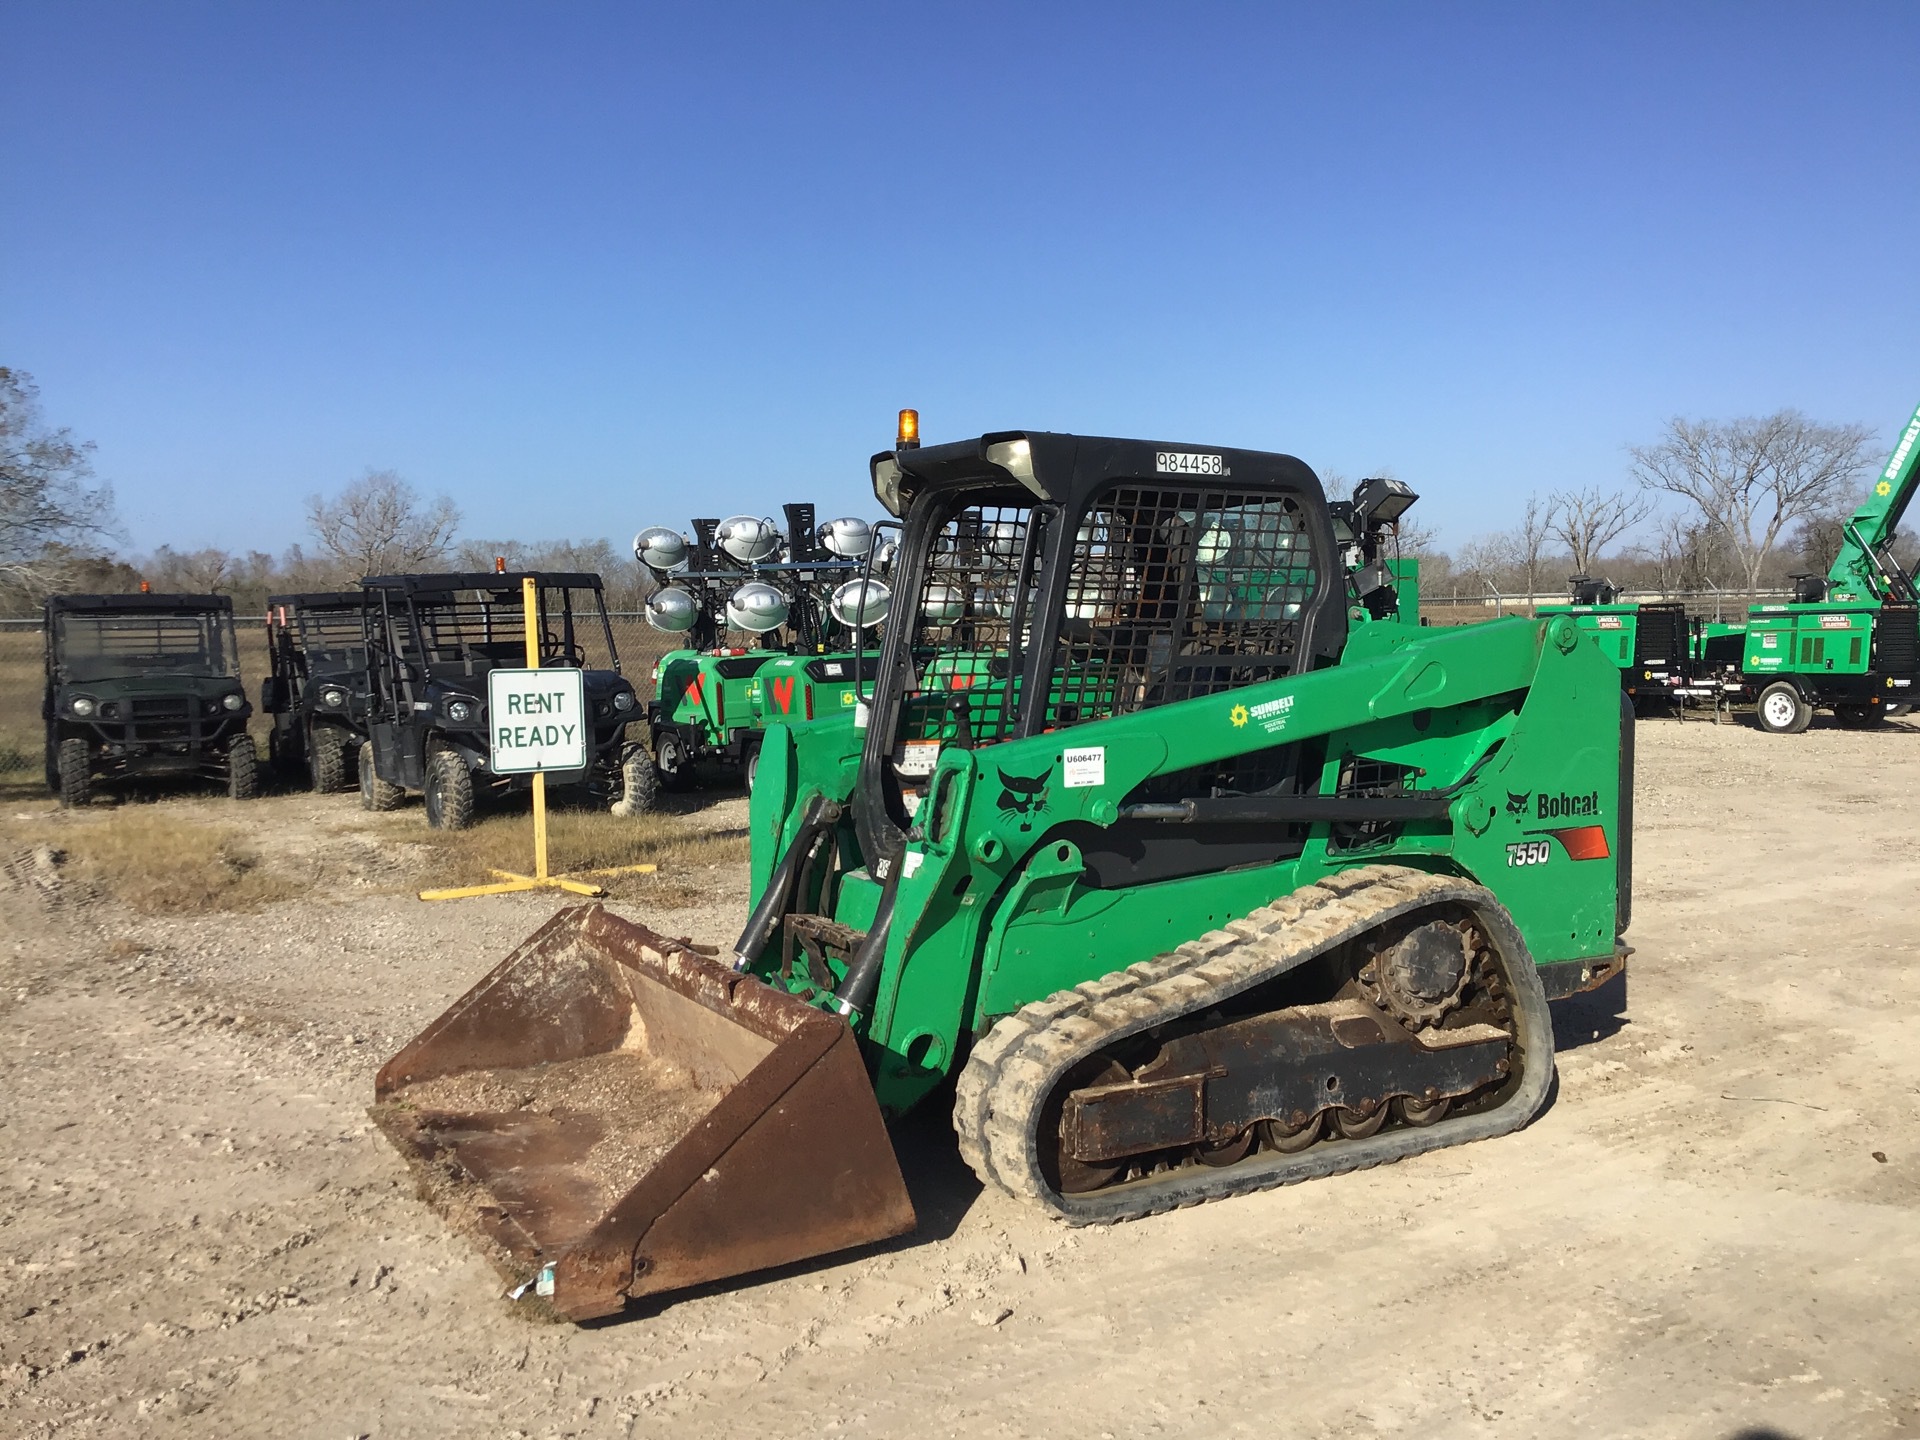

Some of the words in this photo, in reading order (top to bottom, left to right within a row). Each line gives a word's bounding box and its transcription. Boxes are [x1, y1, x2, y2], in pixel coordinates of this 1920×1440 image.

[1885, 417, 1920, 480] SUNBELT
[1157, 453, 1221, 474] 984458
[508, 692, 565, 715] RENT
[1250, 695, 1295, 717] SUNBELT
[1257, 707, 1290, 720] RENTALS
[498, 724, 576, 748] READY
[1067, 754, 1102, 763] U606477
[1537, 791, 1599, 819] Bobcat
[1506, 840, 1551, 868] T550
